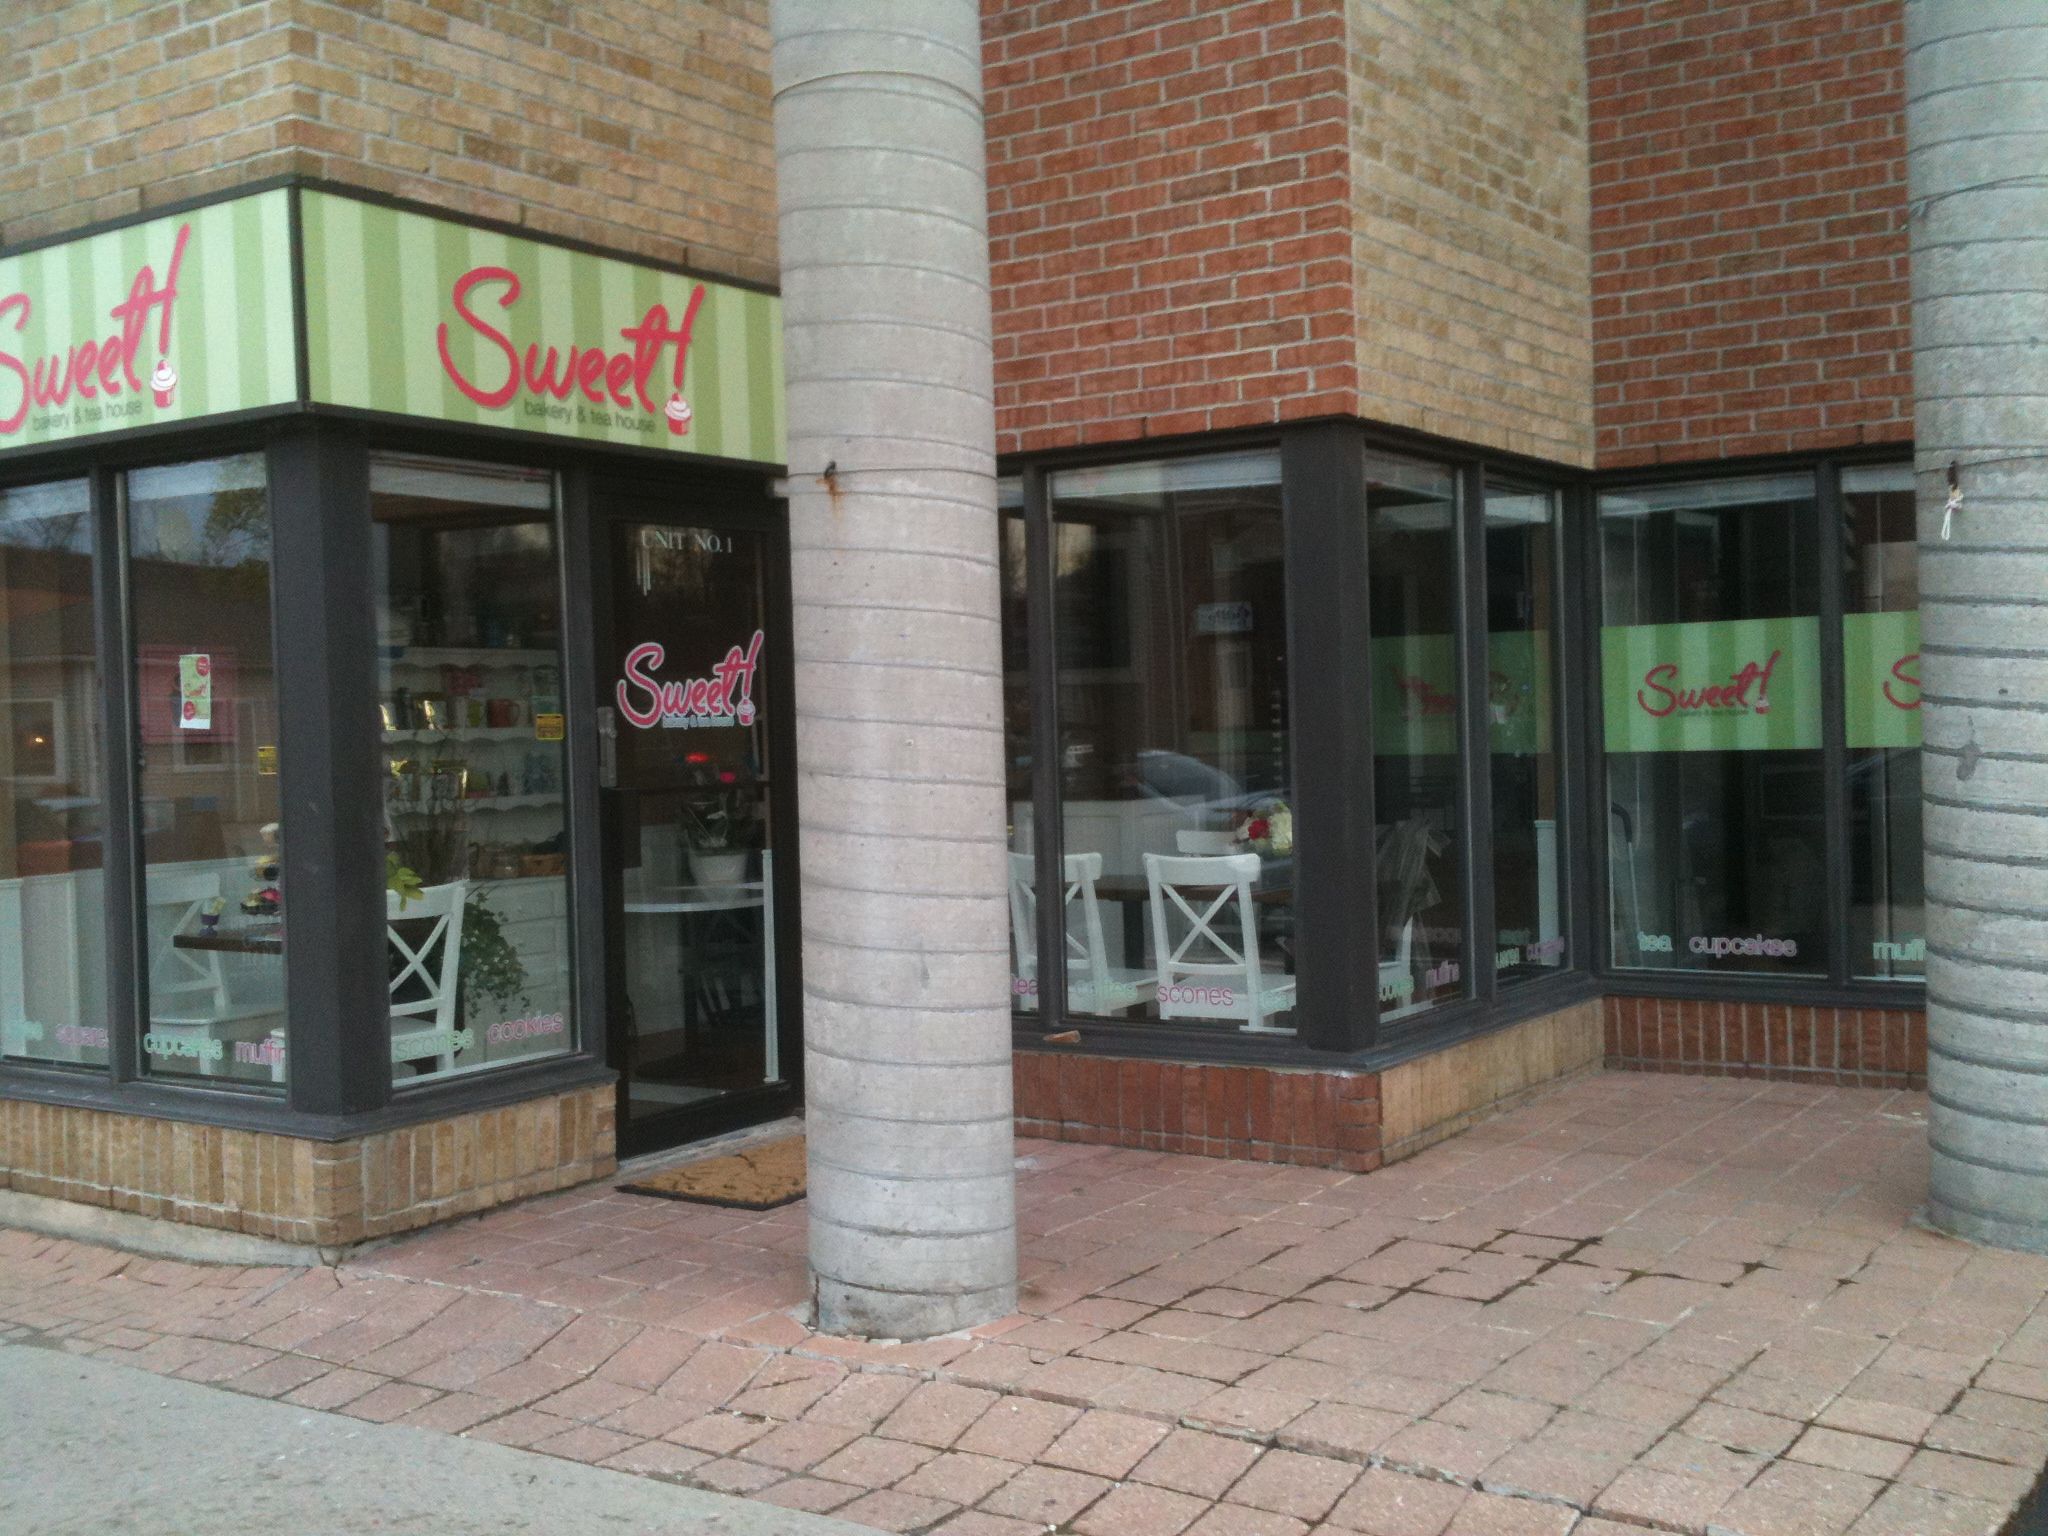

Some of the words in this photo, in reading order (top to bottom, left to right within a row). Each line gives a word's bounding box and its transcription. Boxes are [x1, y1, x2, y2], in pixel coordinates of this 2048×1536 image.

[436, 265, 706, 435] Sweet!
[32, 412, 70, 431] bakery
[105, 400, 143, 418] house
[524, 399, 572, 424] bakery
[577, 405, 586, 423] &
[590, 409, 612, 426] tea
[615, 412, 656, 432] house
[641, 528, 685, 550] UNIT
[617, 629, 764, 728] Sweet!
[1637, 649, 1781, 717] Sweet!
[1632, 931, 1673, 952] tea
[1688, 933, 1798, 958] cupcakes
[1873, 938, 1926, 961] muff
[1157, 984, 1235, 1007] scones
[487, 1011, 566, 1044] cookies
